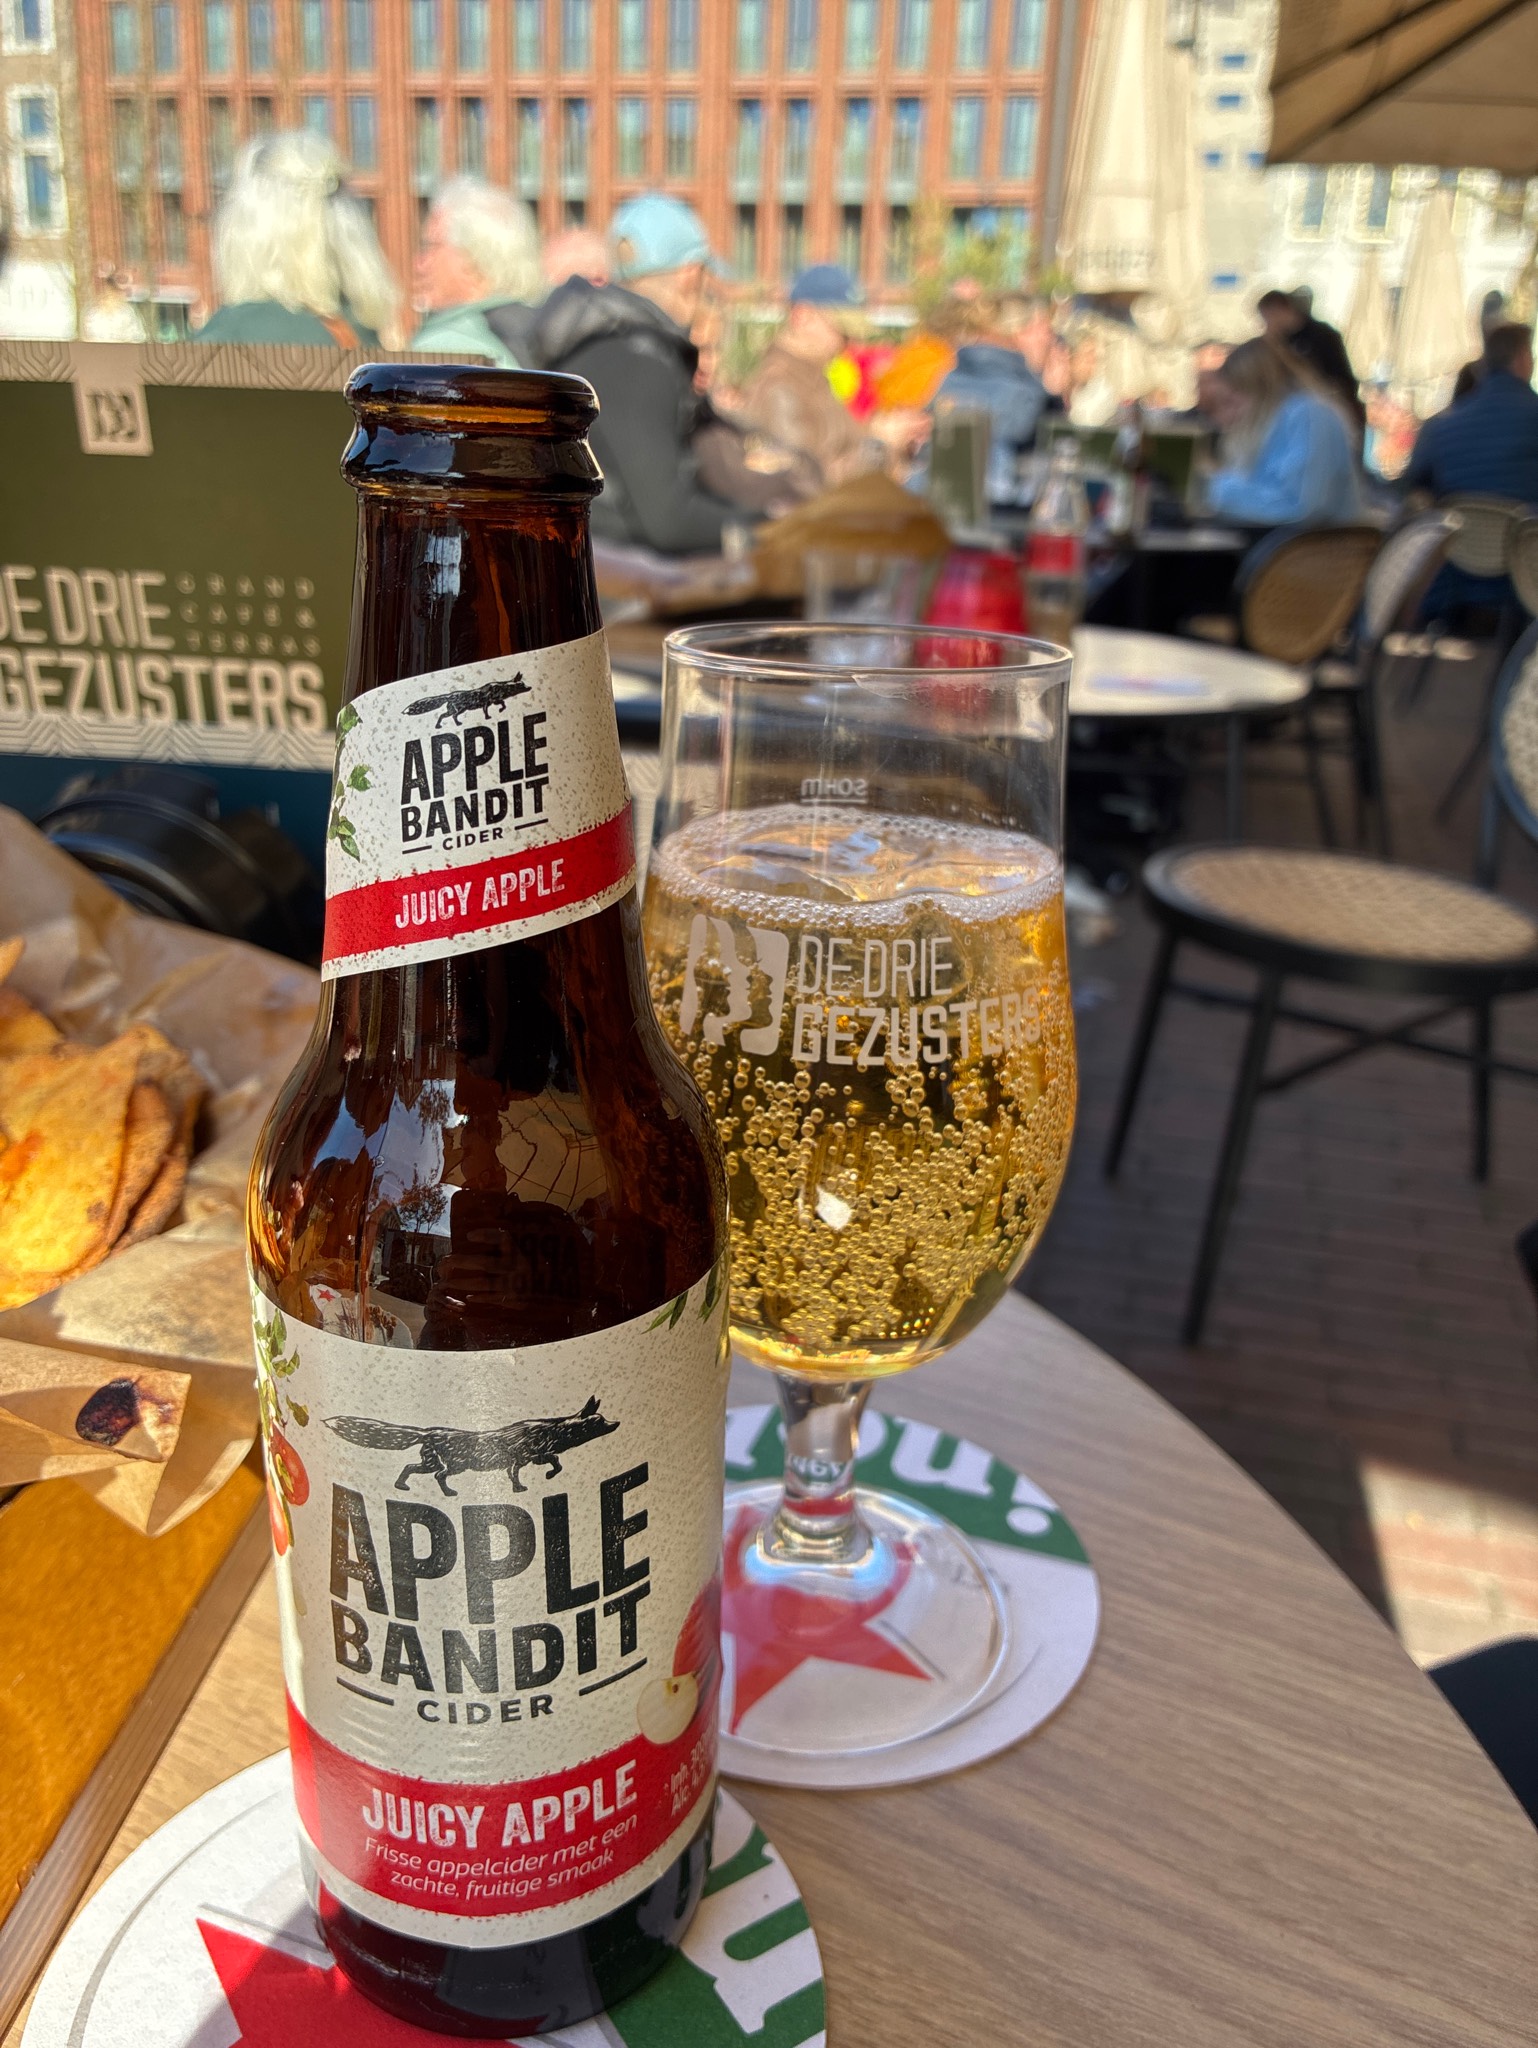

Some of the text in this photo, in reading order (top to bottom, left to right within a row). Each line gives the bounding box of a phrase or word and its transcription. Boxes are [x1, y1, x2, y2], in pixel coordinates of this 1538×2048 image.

[0, 564, 176, 650] E DRIE
[0, 646, 328, 734] GEZUSTERS
[401, 711, 549, 805] APPLE
[401, 776, 549, 843] BANDIT
[442, 827, 504, 851] CIDER
[395, 858, 566, 929] JUICY APPLE
[799, 935, 853, 998] DE
[863, 936, 953, 998] DRIE
[792, 985, 1041, 1067] GEZUSTERS
[329, 1461, 651, 1625] APPLE
[330, 1580, 651, 1694] BANDIT
[416, 1693, 554, 1725] CIDER
[362, 1759, 638, 1849] JUICY APPLE
[365, 1813, 638, 1879] Frisse appelcider met een
[390, 1849, 614, 1901] zachte, fruitige smaak
